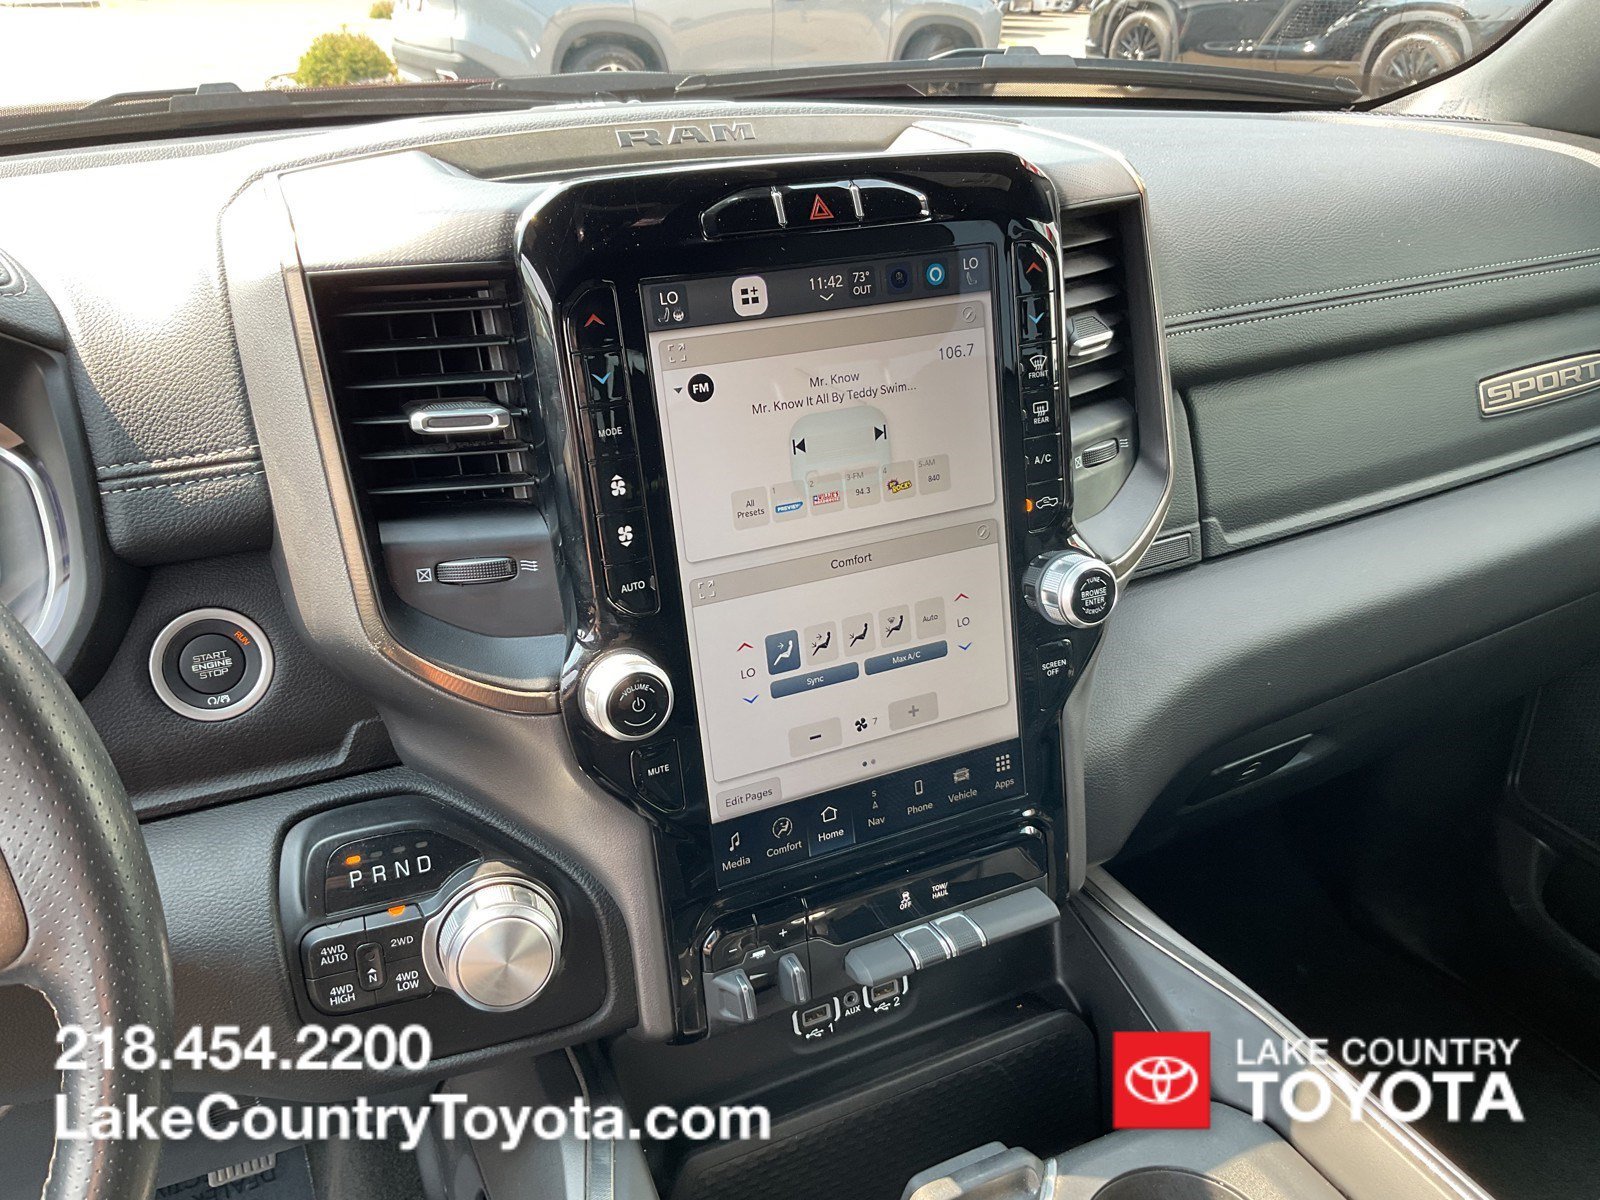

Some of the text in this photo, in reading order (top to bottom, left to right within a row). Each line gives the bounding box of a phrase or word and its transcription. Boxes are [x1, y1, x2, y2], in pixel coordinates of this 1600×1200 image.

[616, 122, 755, 148] RAM
[963, 257, 978, 270] LO
[809, 275, 843, 290] 11:42
[852, 271, 870, 283] 73°
[853, 284, 872, 295] OUT
[659, 291, 679, 305] LO
[938, 343, 974, 360] 106.7
[809, 372, 860, 387] Mr. Know
[1028, 370, 1049, 379] FRONT
[692, 382, 709, 394] FM
[1487, 361, 1600, 405] SPORT
[752, 403, 771, 415] Mr.
[773, 396, 803, 411] Know
[806, 395, 813, 407] It
[815, 393, 829, 405] All
[832, 391, 844, 405] By
[847, 385, 878, 401] Teddy
[1033, 416, 1049, 424] REAR
[598, 426, 622, 438] MODE
[918, 459, 936, 468] 5-AM
[1034, 454, 1051, 465] A/C
[846, 472, 864, 480] 3-FM
[928, 473, 941, 482] 840
[855, 487, 871, 496] 94.3
[745, 499, 755, 507] All
[737, 508, 765, 518] Presets
[830, 553, 873, 569] Comfort
[621, 580, 646, 593] AUTO
[1081, 587, 1106, 597] BROWSE
[1084, 597, 1105, 606] ENTER
[1085, 605, 1104, 613] SCROLL
[922, 612, 938, 623] Auto
[957, 616, 970, 628] LO
[234, 630, 250, 646] RUN
[193, 650, 227, 662] START
[192, 658, 231, 671] ENGINE
[1042, 659, 1067, 671] SCREEN
[200, 668, 229, 680] STOP
[740, 667, 756, 679] LO
[1047, 667, 1060, 677] OFF
[806, 674, 824, 686] Sync
[622, 684, 650, 695] VOLUME
[873, 717, 878, 725] 7
[647, 764, 670, 776] MUTE
[995, 777, 1015, 790] Apps
[725, 788, 773, 808] Edit Pages
[948, 787, 978, 803] Vehicle
[907, 801, 933, 815] Phone
[867, 816, 885, 827] Nav
[818, 827, 845, 842] Home
[766, 839, 802, 858] Comfort
[722, 855, 751, 872] Media
[349, 855, 432, 888] P R N D
[932, 882, 949, 893] TOW/
[932, 888, 949, 900] HAUL
[900, 900, 912, 911] OFF
[390, 935, 414, 947] 2WD
[320, 944, 345, 956] 4WD
[320, 952, 348, 966] AUTO
[368, 973, 378, 983] N
[395, 970, 419, 982] 4WD
[329, 983, 354, 997] 4WD
[397, 979, 420, 992] LOW
[329, 993, 356, 1006] HIGH
[893, 996, 900, 1007] 2
[845, 1006, 861, 1016] AUX
[828, 1022, 834, 1033] 1
